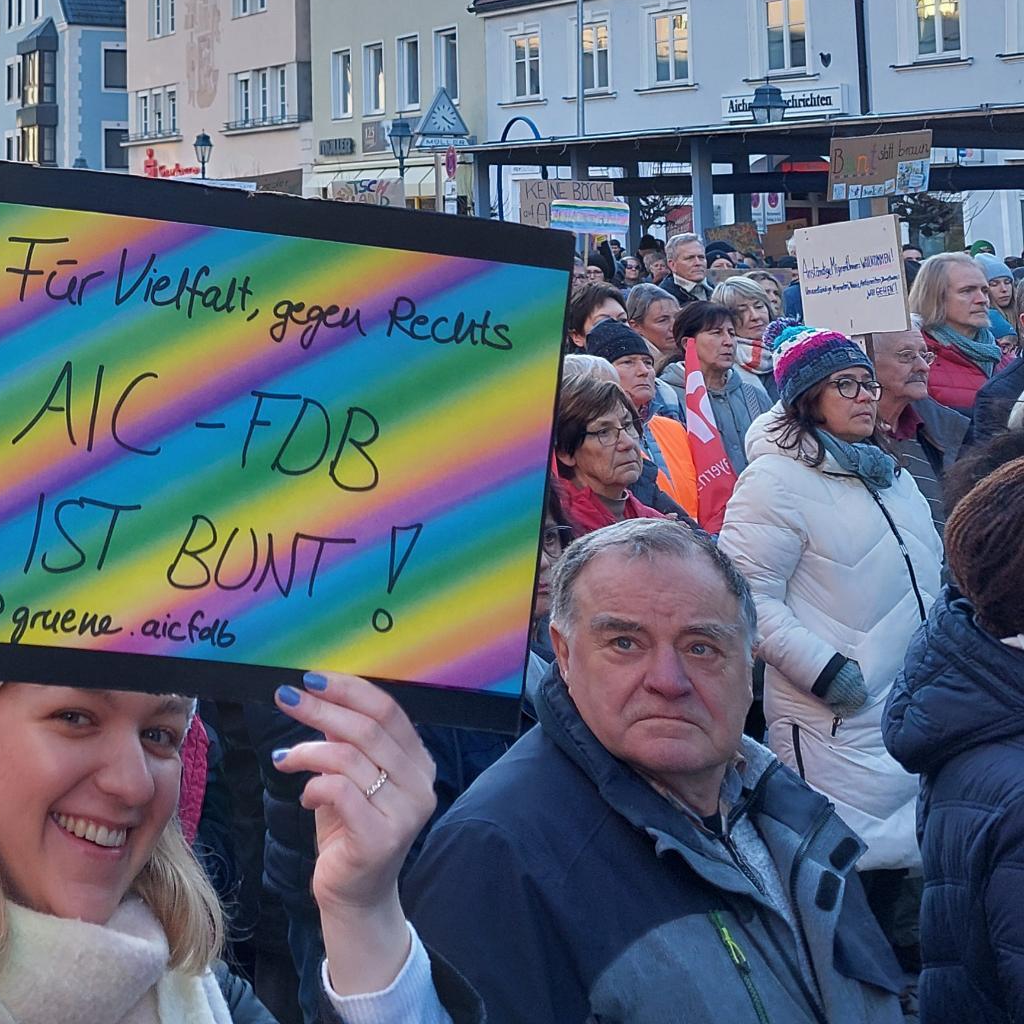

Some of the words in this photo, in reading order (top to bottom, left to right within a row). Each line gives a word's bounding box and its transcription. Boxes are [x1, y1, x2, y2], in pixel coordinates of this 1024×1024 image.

[898, 139, 930, 157] braun
[525, 181, 569, 200] KEINE
[572, 181, 613, 201] BÖCKE
[5, 236, 105, 308] Für
[114, 248, 260, 323] Vielfalt,
[270, 297, 368, 350] gegen
[387, 296, 515, 352] Rechts
[23, 493, 142, 575] IST
